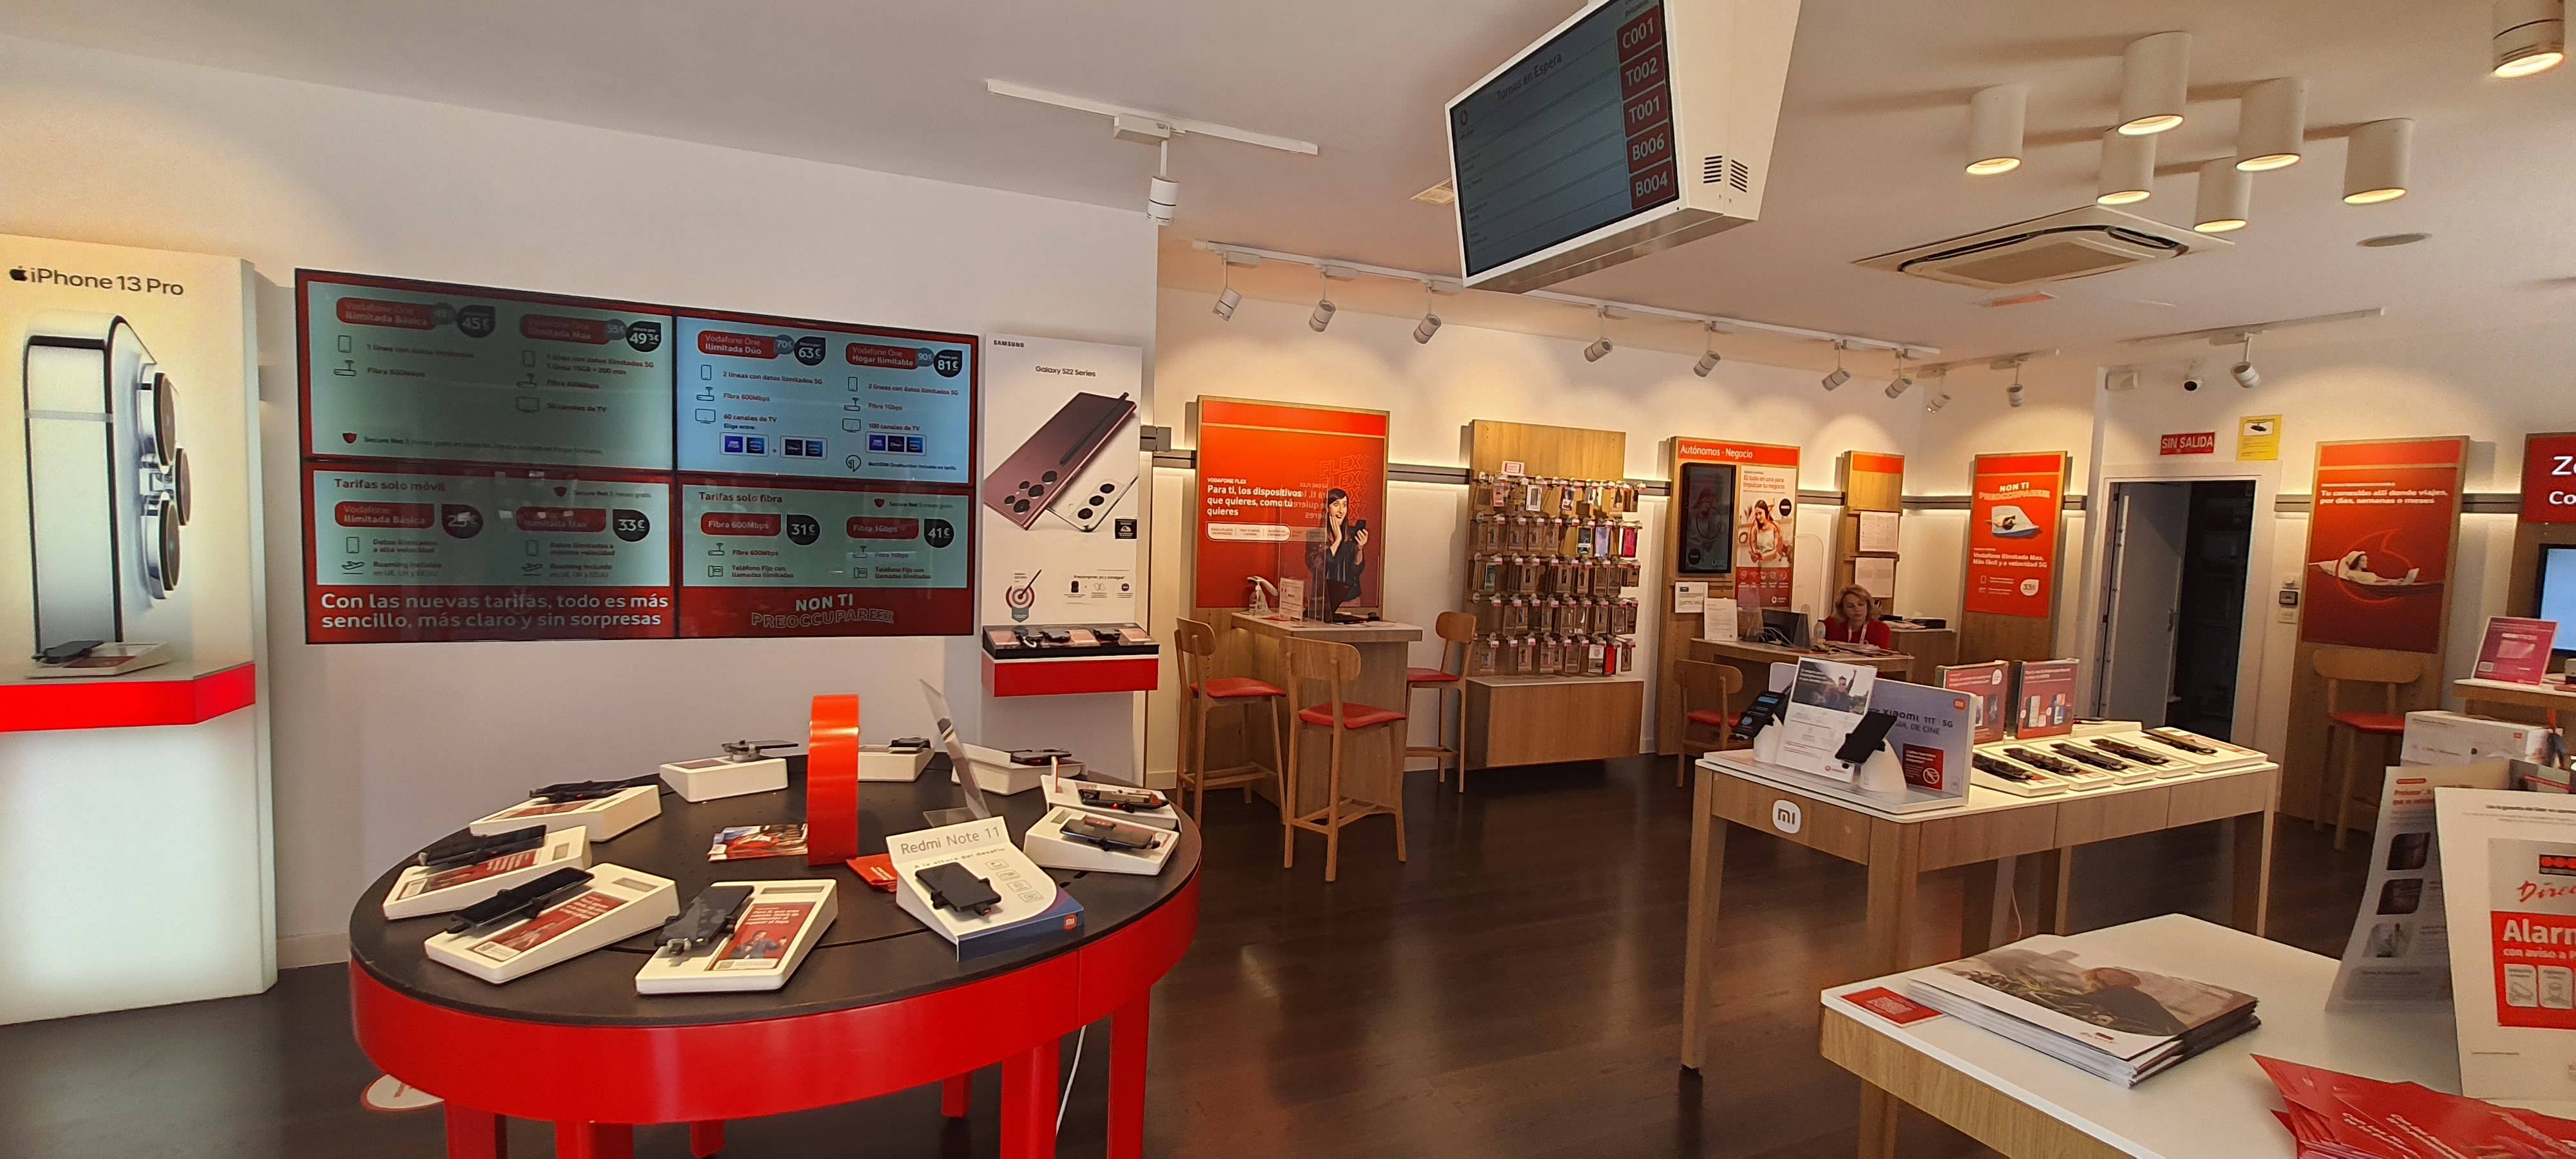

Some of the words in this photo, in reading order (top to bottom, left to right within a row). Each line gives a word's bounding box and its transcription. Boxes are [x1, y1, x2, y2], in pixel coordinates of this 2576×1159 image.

[1623, 17, 1654, 50] C001
[1522, 71, 1533, 85] en
[1534, 53, 1562, 79] Espera
[1625, 56, 1658, 87] T002
[1629, 95, 1660, 124] T001
[1633, 132, 1665, 162] B006
[1635, 169, 1668, 198] B004
[31, 268, 113, 289] iPhone
[117, 275, 142, 292] 13
[146, 278, 184, 296] Pro
[705, 334, 744, 346] Vodafone
[744, 337, 761, 347] One
[993, 339, 1025, 348] SAMSUNG
[705, 343, 744, 353] Ilimitada
[798, 347, 822, 359] 63€
[852, 346, 887, 357] Vodafone
[887, 348, 903, 357] One
[851, 354, 876, 364] Hogar
[877, 357, 914, 367] Ilimitable
[937, 359, 960, 372] 81€
[1035, 366, 1061, 375] Galaxy
[741, 394, 771, 402] 600Mbps
[2162, 437, 2179, 449] SIN
[2179, 434, 2214, 449] SALIDA
[1680, 444, 1721, 457] Autónomos
[1725, 448, 1754, 460] Negocio
[334, 478, 379, 489] Tarifas
[380, 480, 408, 490] solo
[410, 481, 446, 492] móvil
[1208, 484, 1227, 495] Para
[1228, 485, 1237, 495] ti,
[1238, 485, 1252, 495] los
[1253, 486, 1303, 498] dispositivos
[1999, 482, 2020, 493] NON
[2020, 481, 2030, 489] TI
[699, 492, 734, 502] Tarifas
[736, 493, 758, 502] solo
[759, 493, 783, 504] fibra
[1207, 496, 1224, 506] que
[1225, 496, 1259, 507] quieres,
[1260, 498, 1284, 507] como
[1284, 498, 1294, 507] tú
[2548, 491, 2576, 505] Co
[343, 505, 391, 514] Vodafone
[1207, 506, 1239, 517] quieres
[343, 514, 391, 524] Ilimitada
[617, 519, 647, 532] 33€
[708, 520, 730, 529] Fibra
[731, 521, 769, 531] 600Mbps
[791, 523, 816, 536] 31€
[875, 525, 898, 534] 1Gbps
[927, 527, 951, 539] 41€
[322, 593, 363, 609] Con
[370, 594, 400, 609] las
[405, 596, 480, 610] nuevas
[484, 593, 553, 612] tarifas,
[557, 593, 600, 610] todo
[605, 597, 627, 610] es
[630, 593, 669, 608] más
[795, 596, 834, 612] NON
[837, 592, 854, 608] TI
[321, 612, 413, 630] sencillo,
[418, 612, 461, 629] más
[465, 612, 515, 628] claro
[518, 616, 532, 632] y
[537, 613, 565, 628] sin
[570, 612, 662, 631] sorpresas
[1909, 723, 1921, 731] DE
[1922, 726, 1942, 735] CINE
[1942, 719, 1954, 728] 5G
[900, 836, 942, 855] Redmi
[946, 831, 980, 847] Note
[983, 825, 1001, 840] 11
